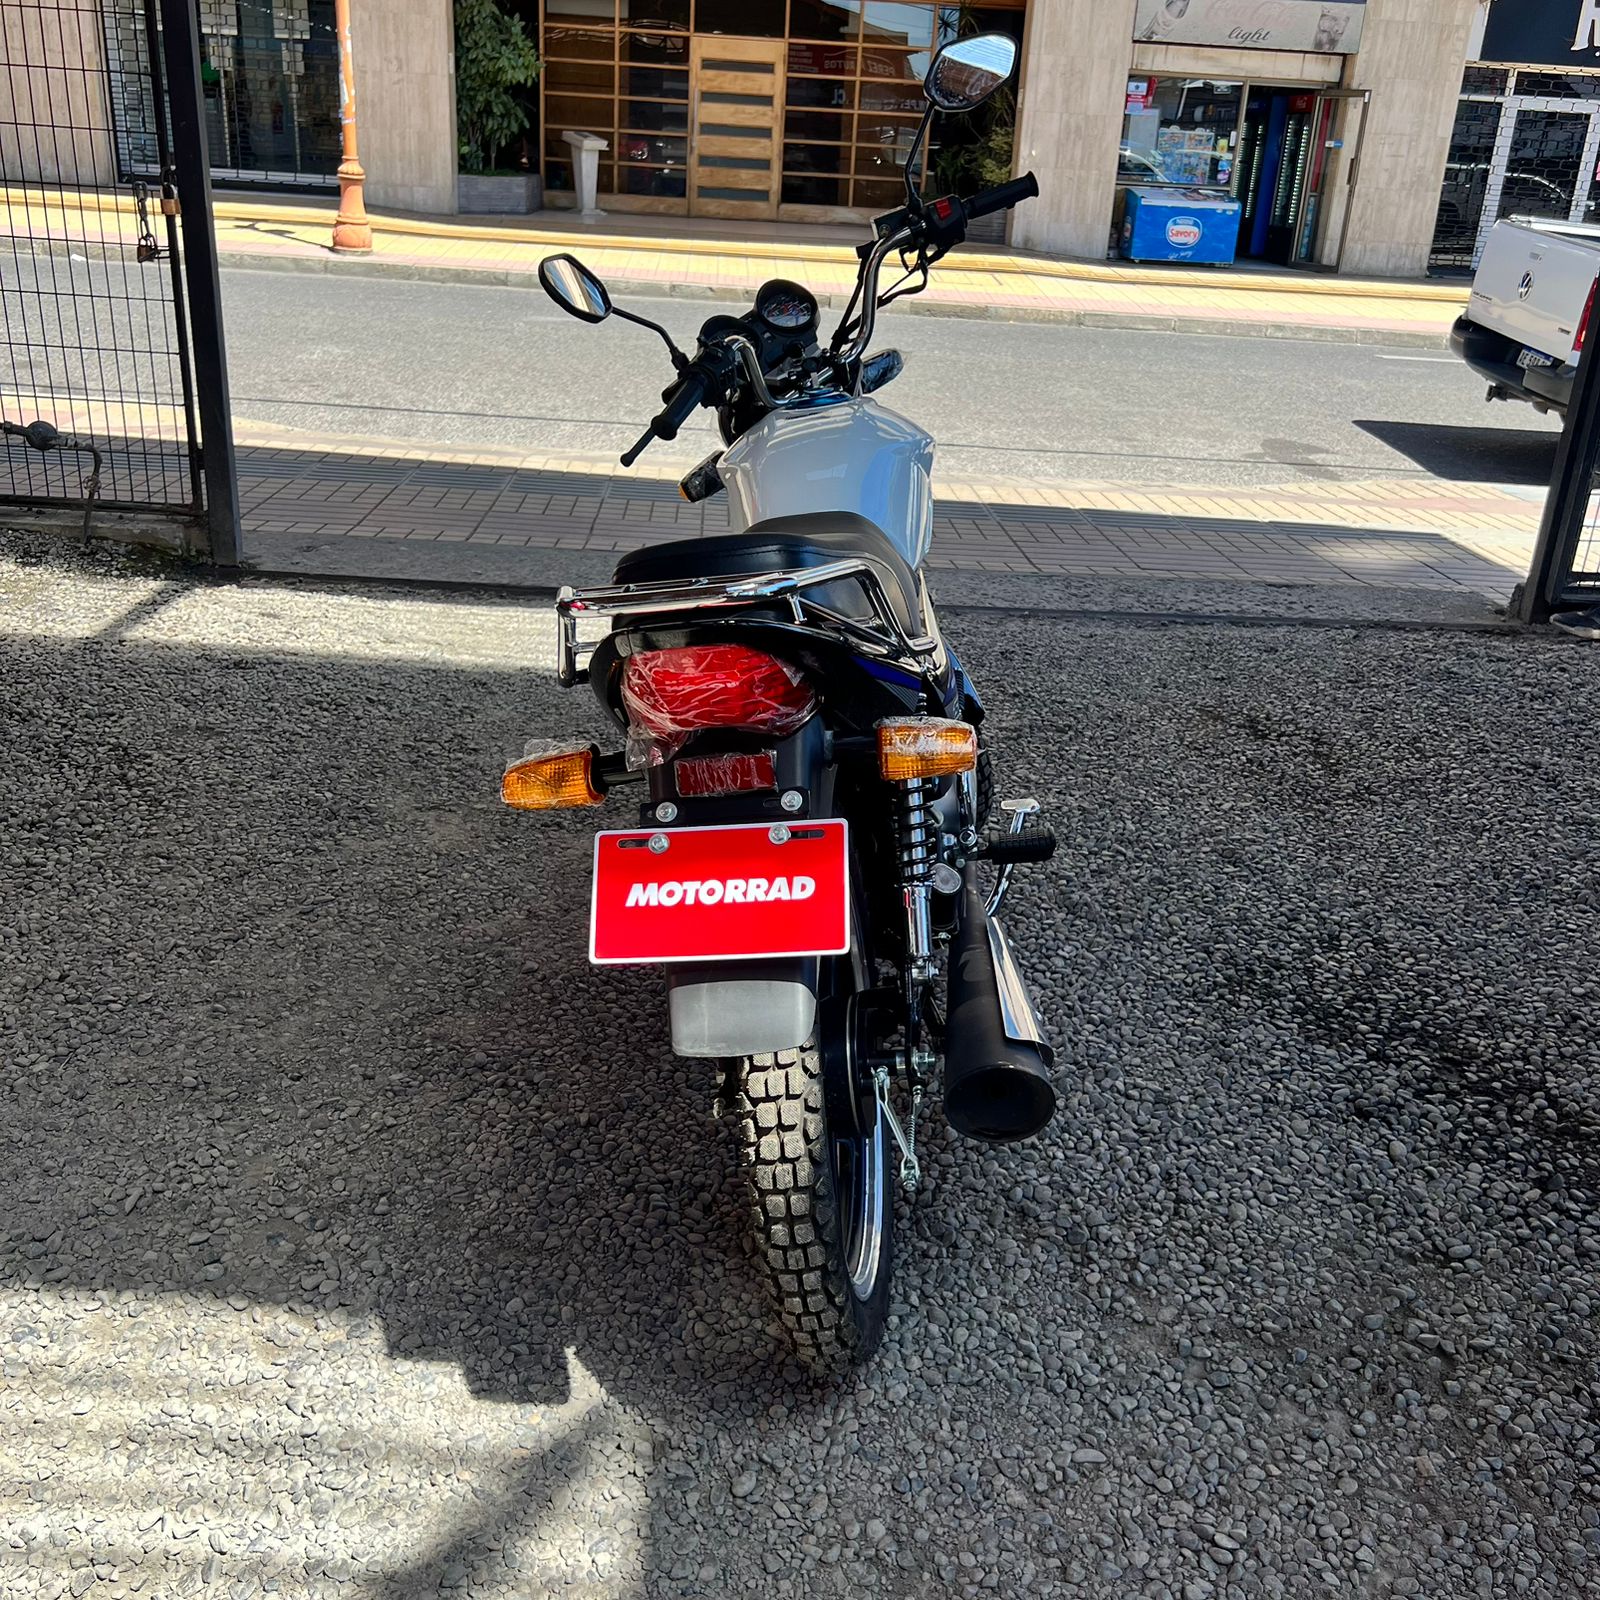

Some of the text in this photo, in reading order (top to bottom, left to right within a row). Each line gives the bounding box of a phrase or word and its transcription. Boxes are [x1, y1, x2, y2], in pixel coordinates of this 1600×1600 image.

[1228, 26, 1271, 44] light
[1169, 228, 1199, 240] Savory
[624, 876, 816, 907] MOTORRAD
